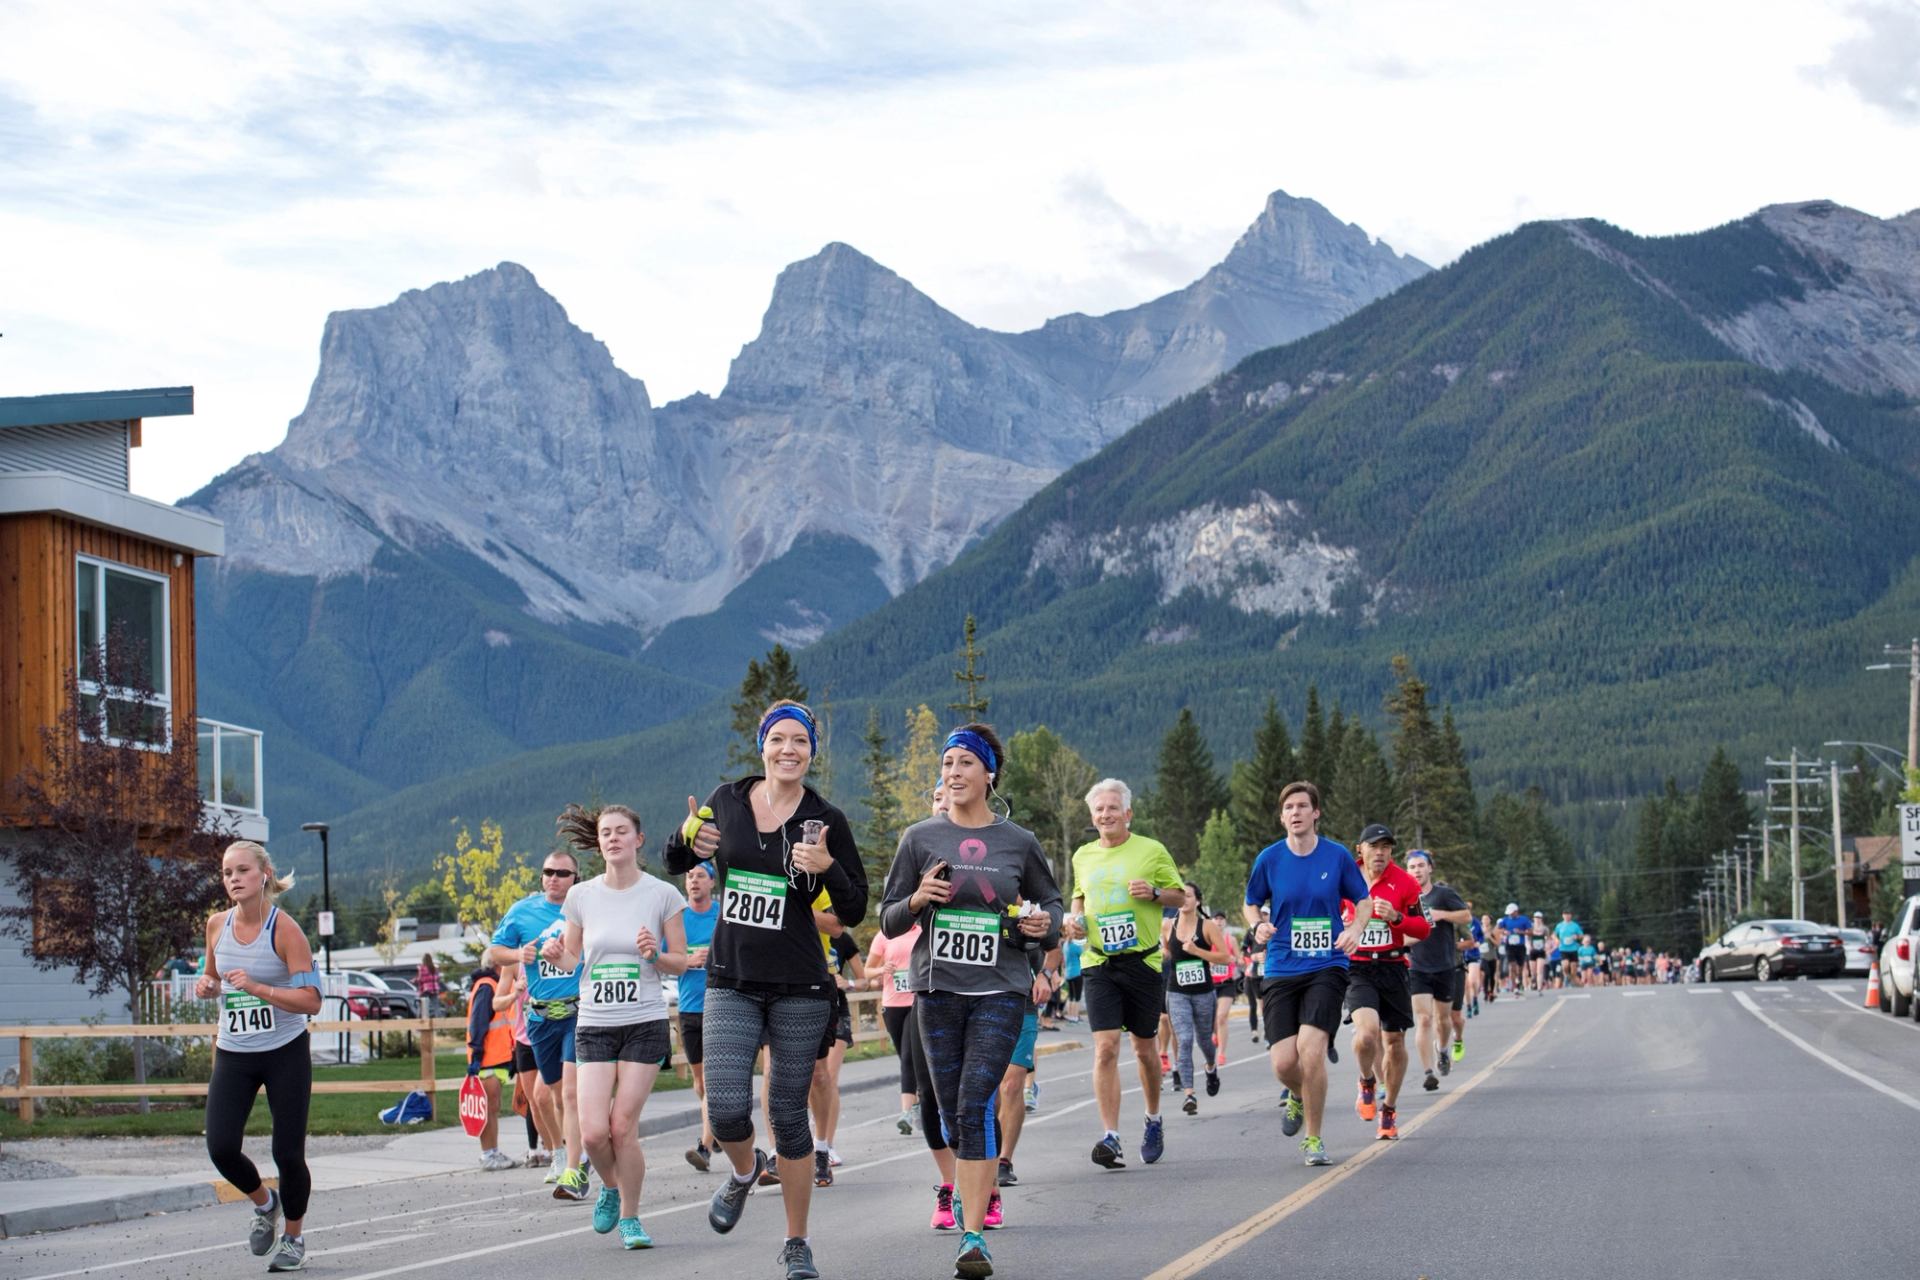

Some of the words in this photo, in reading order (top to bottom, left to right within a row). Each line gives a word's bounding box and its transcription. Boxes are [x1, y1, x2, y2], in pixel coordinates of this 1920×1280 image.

[726, 891, 781, 926] 2804
[1101, 923, 1135, 943] 2123
[1294, 931, 1329, 949] 2855
[1361, 930, 1390, 945] 2477
[937, 930, 995, 963] 2803
[541, 961, 574, 977] 24
[1178, 969, 1204, 984] 2853
[593, 981, 638, 1004] 2802
[228, 1007, 272, 1033] 2140
[461, 1093, 486, 1121] STOP
